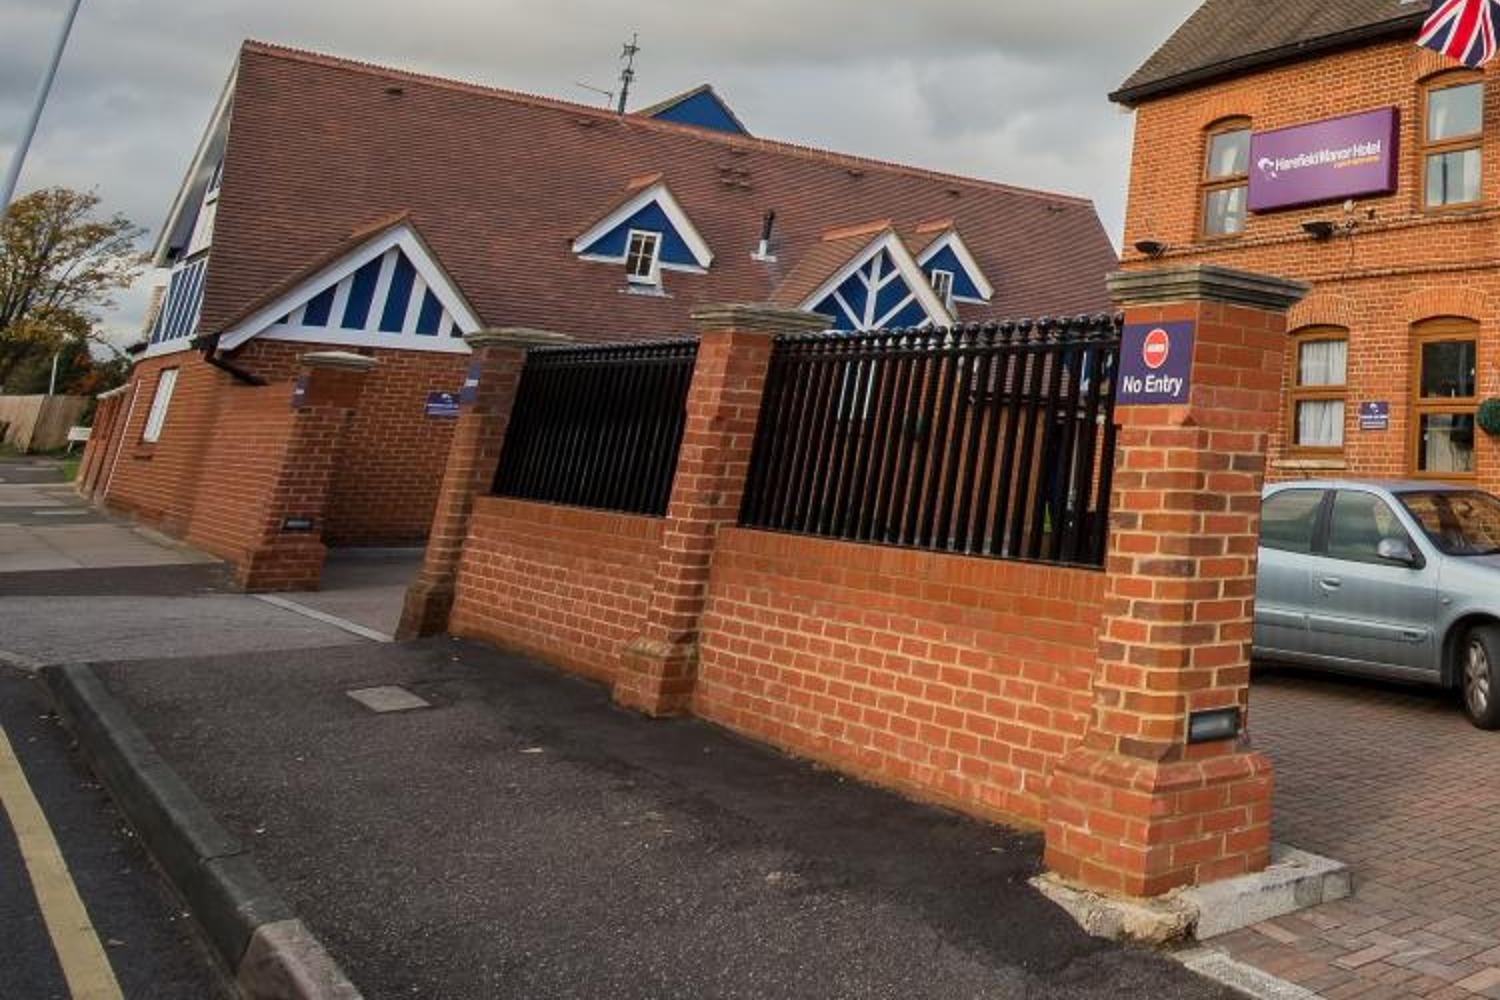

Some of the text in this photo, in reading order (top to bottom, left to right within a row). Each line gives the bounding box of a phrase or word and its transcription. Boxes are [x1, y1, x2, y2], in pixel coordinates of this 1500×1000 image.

[1275, 151, 1319, 171] Harefield
[1320, 148, 1351, 163] Manor
[1353, 139, 1381, 156] Hotel
[1122, 374, 1183, 397] No Entry
